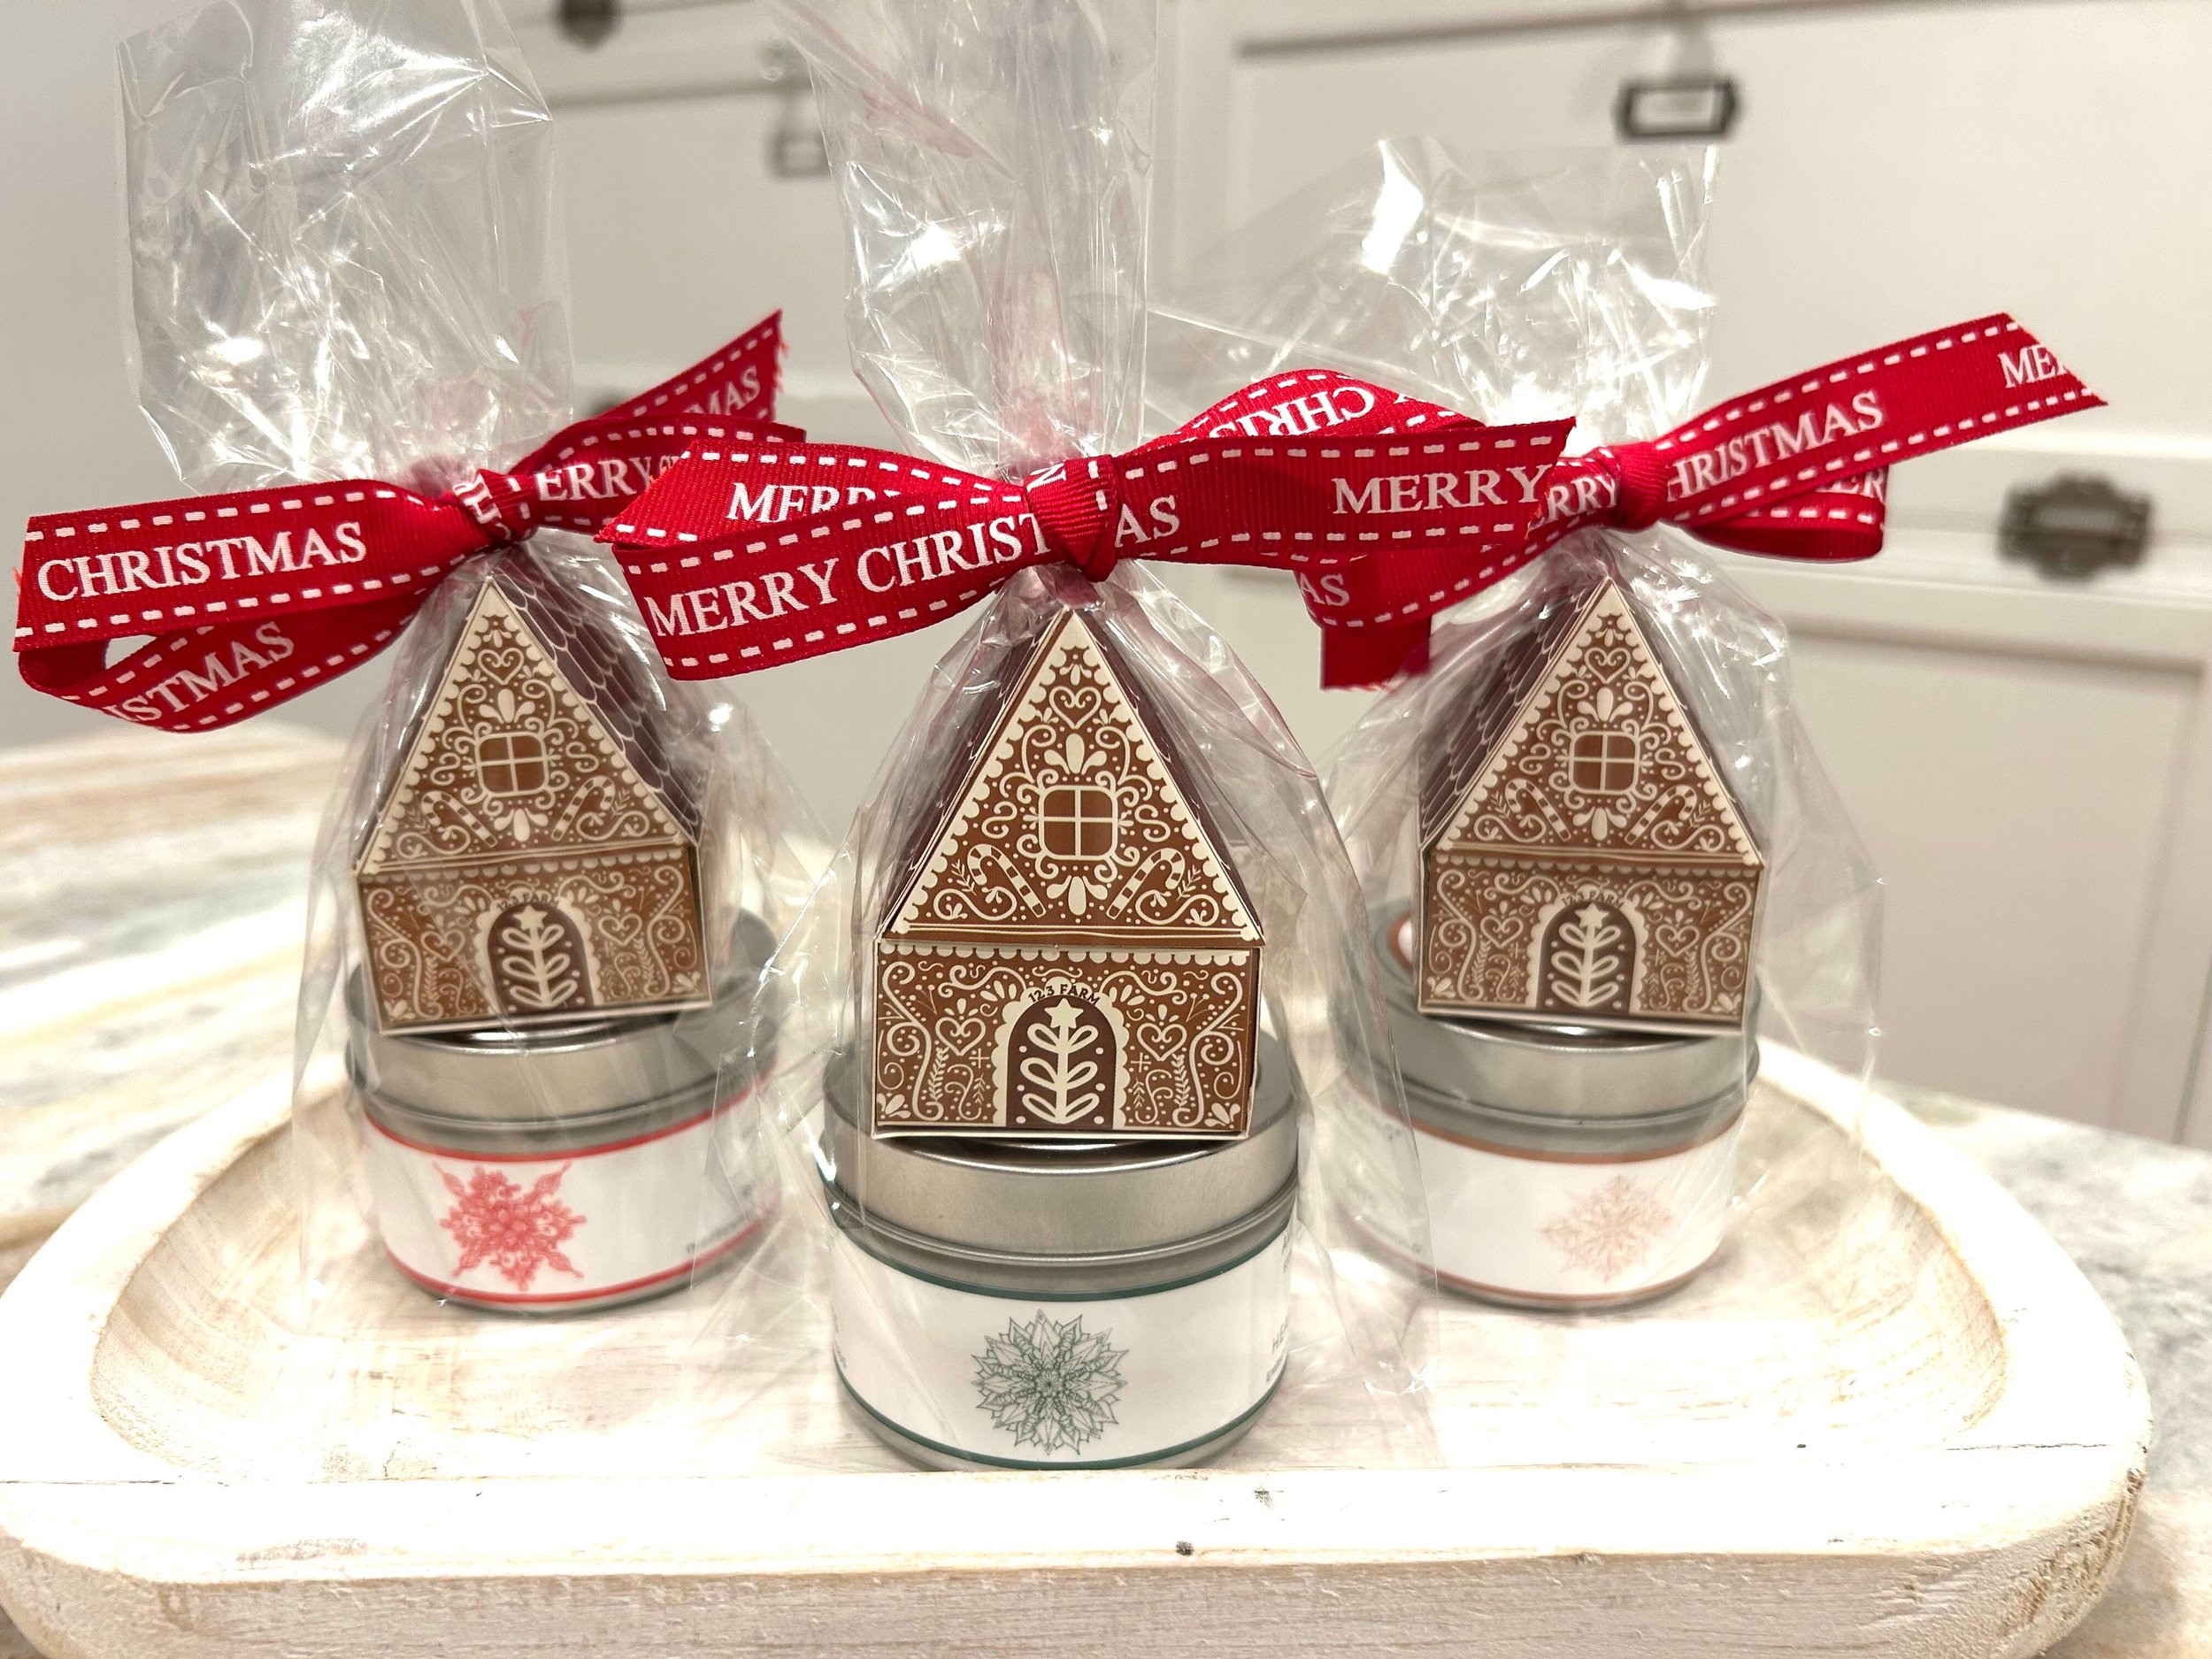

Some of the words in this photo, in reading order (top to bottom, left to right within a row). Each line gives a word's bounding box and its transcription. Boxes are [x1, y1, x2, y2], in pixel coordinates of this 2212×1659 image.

[534, 456, 653, 502] ERRY
[1666, 390, 1883, 503] HRISTMAS
[1332, 463, 1554, 515] MERRY
[37, 521, 366, 603] CHRISTMAS
[643, 557, 840, 638] MERRY
[856, 495, 1181, 594] CHRISTAS
[1028, 985, 1055, 1003] 123
[1060, 984, 1100, 1005] FARM
